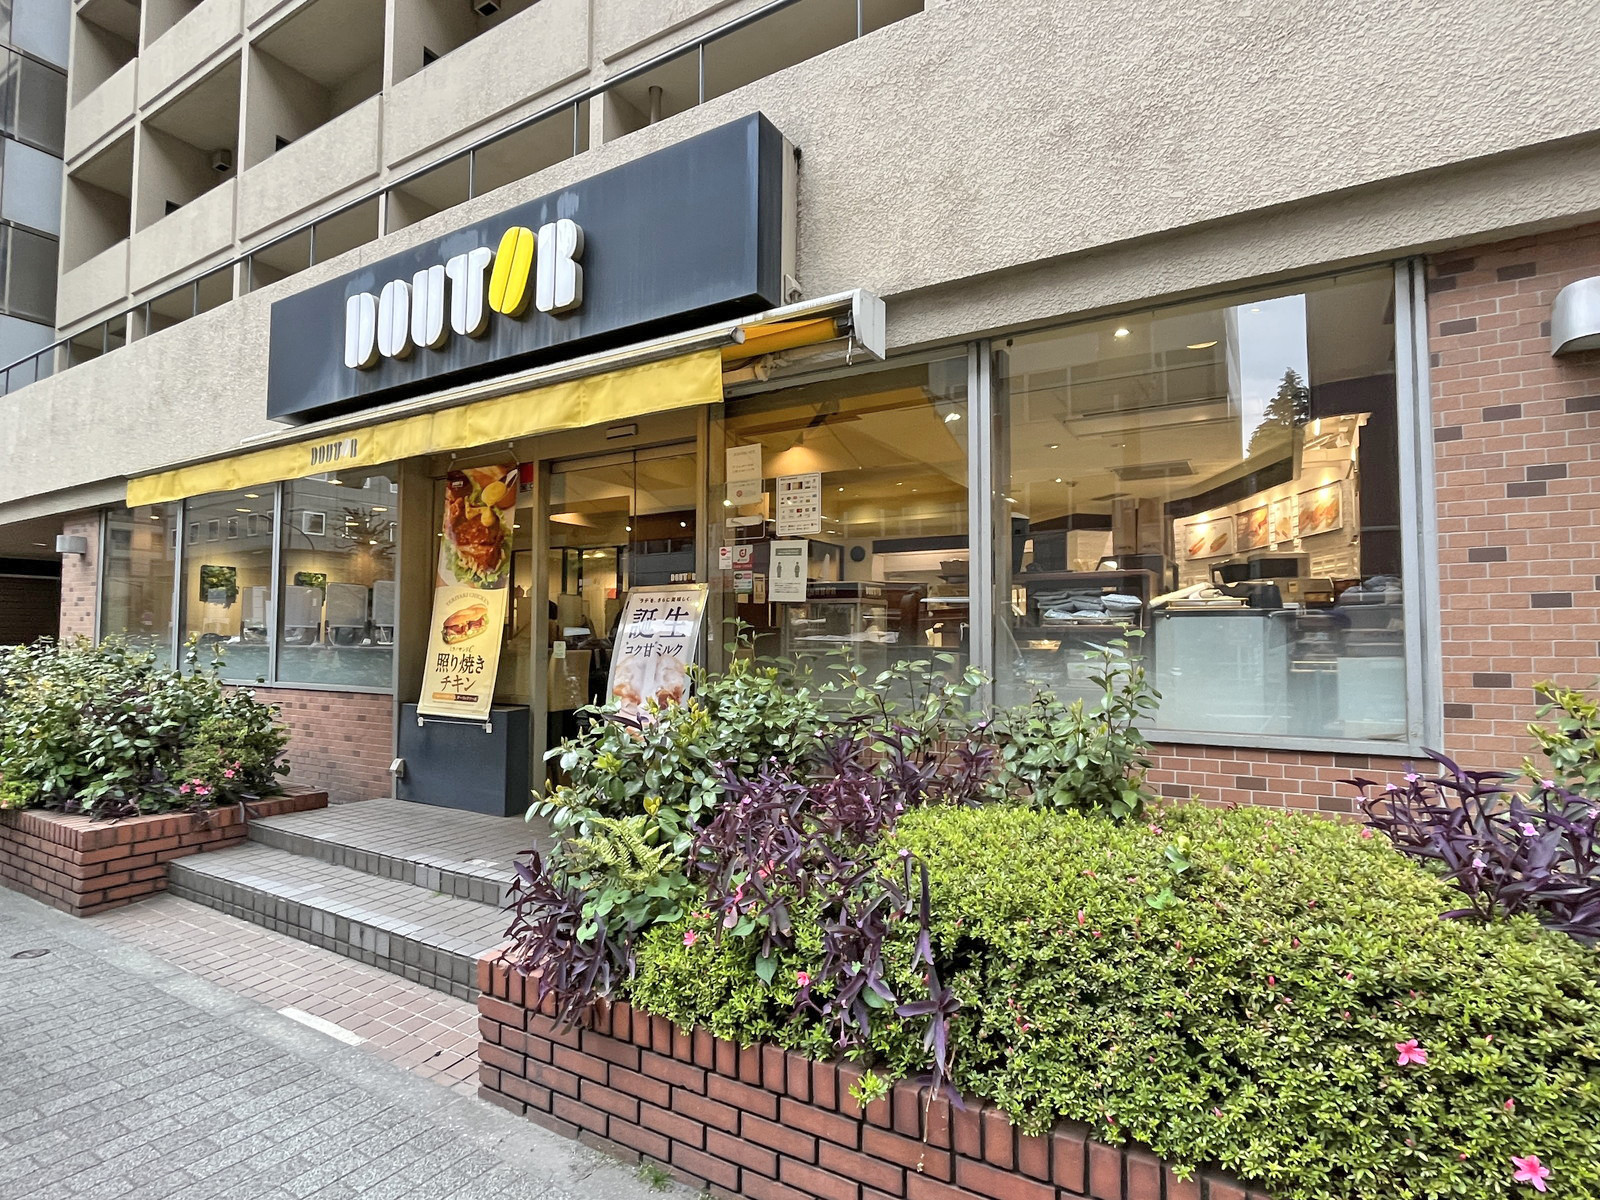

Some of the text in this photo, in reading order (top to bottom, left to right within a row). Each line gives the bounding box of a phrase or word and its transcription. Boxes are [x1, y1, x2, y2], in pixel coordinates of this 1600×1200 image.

[344, 218, 583, 370] DOUTOR
[311, 438, 358, 466] DOUTOR
[628, 606, 690, 639] 誕生
[435, 653, 485, 674] 照り焼き
[440, 674, 477, 693] チキン
